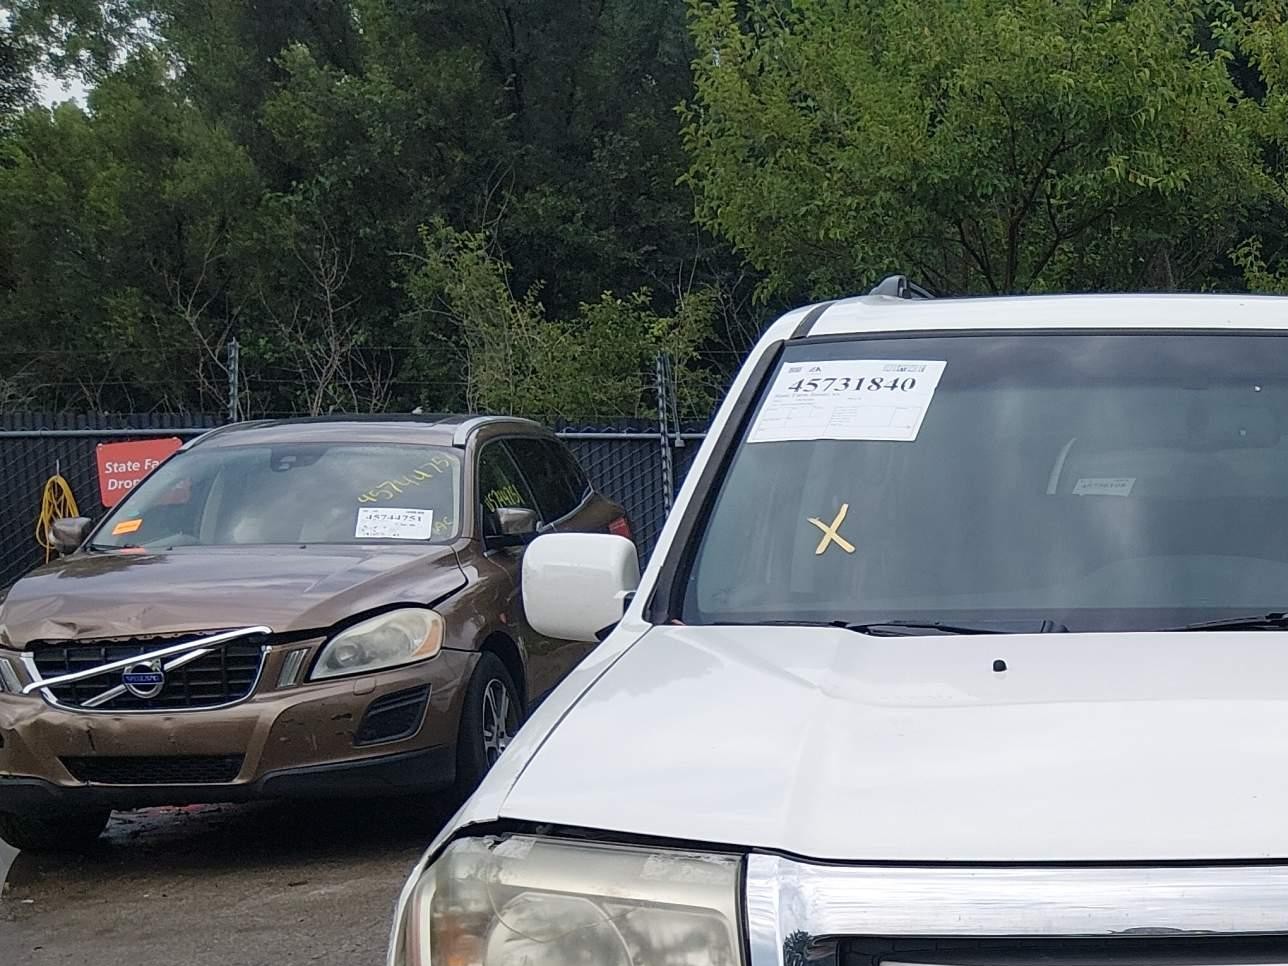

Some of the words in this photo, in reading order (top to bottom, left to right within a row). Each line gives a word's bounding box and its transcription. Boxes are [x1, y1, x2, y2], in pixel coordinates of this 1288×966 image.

[788, 377, 916, 393] 45731840
[104, 461, 141, 474] State
[144, 458, 162, 471] Fa
